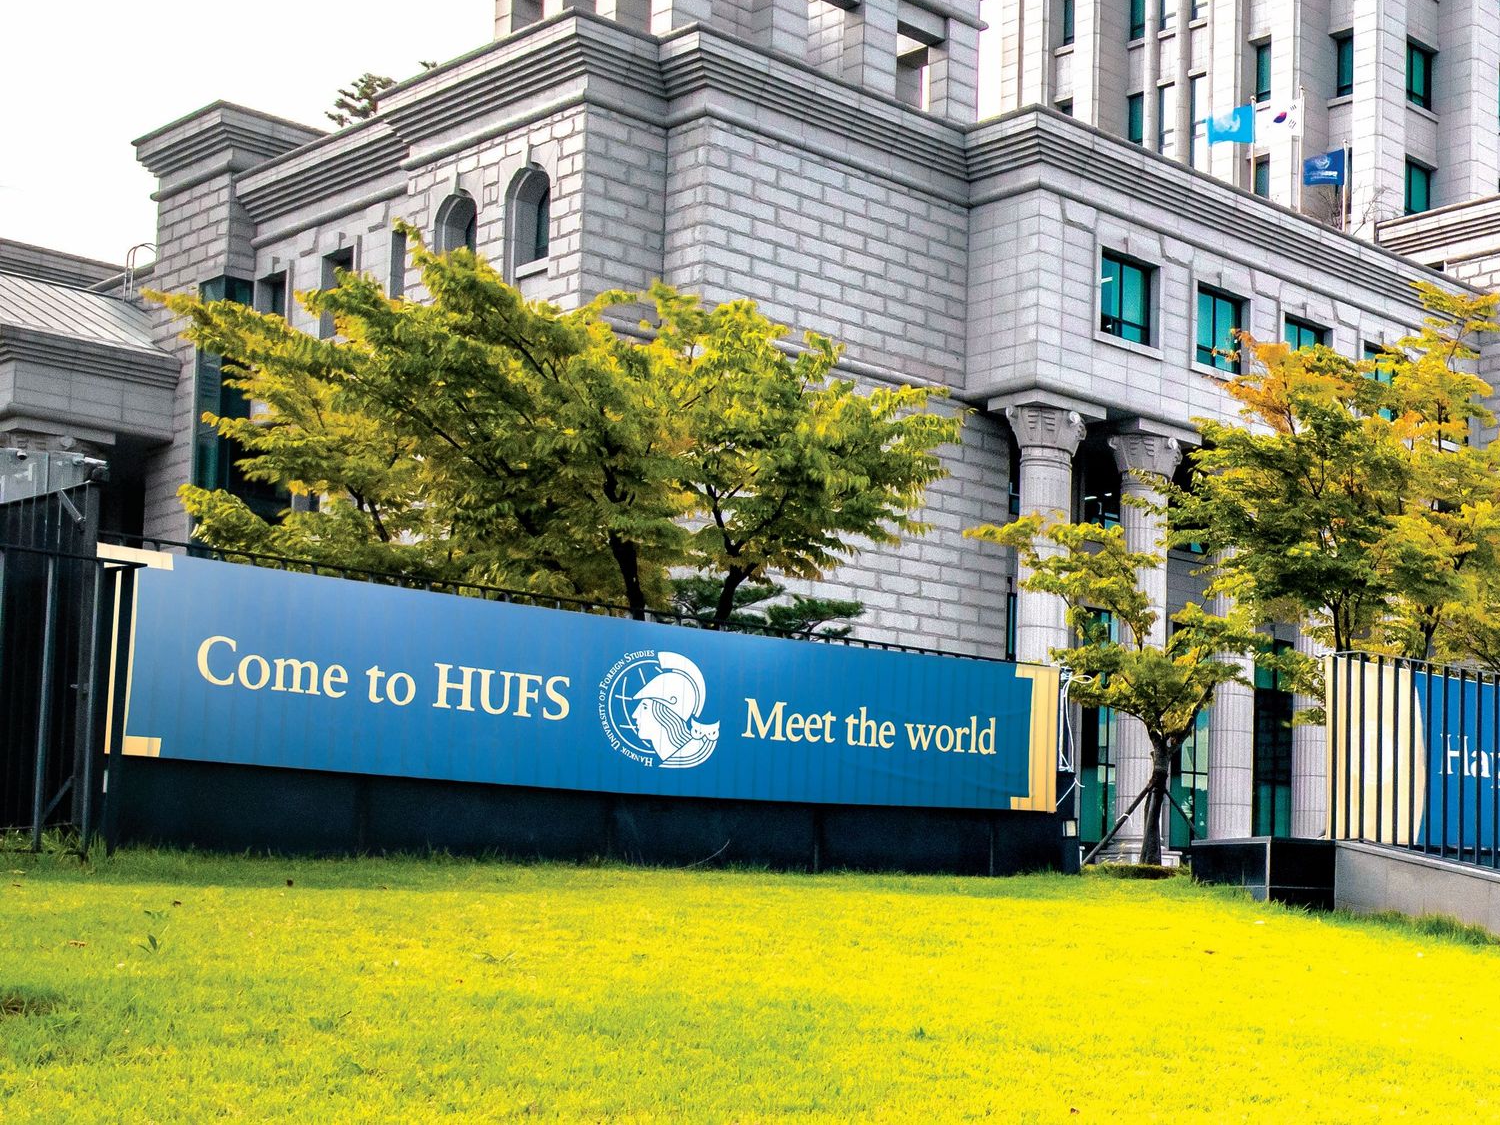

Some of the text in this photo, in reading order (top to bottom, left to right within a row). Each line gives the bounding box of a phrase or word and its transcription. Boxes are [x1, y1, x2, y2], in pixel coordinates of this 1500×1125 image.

[197, 635, 571, 721] Come to HUFS
[598, 660, 625, 690] FOREIGN
[624, 650, 655, 662] STUDIES
[598, 703, 620, 751] UNIVERSITY
[742, 698, 997, 755] Meet the world
